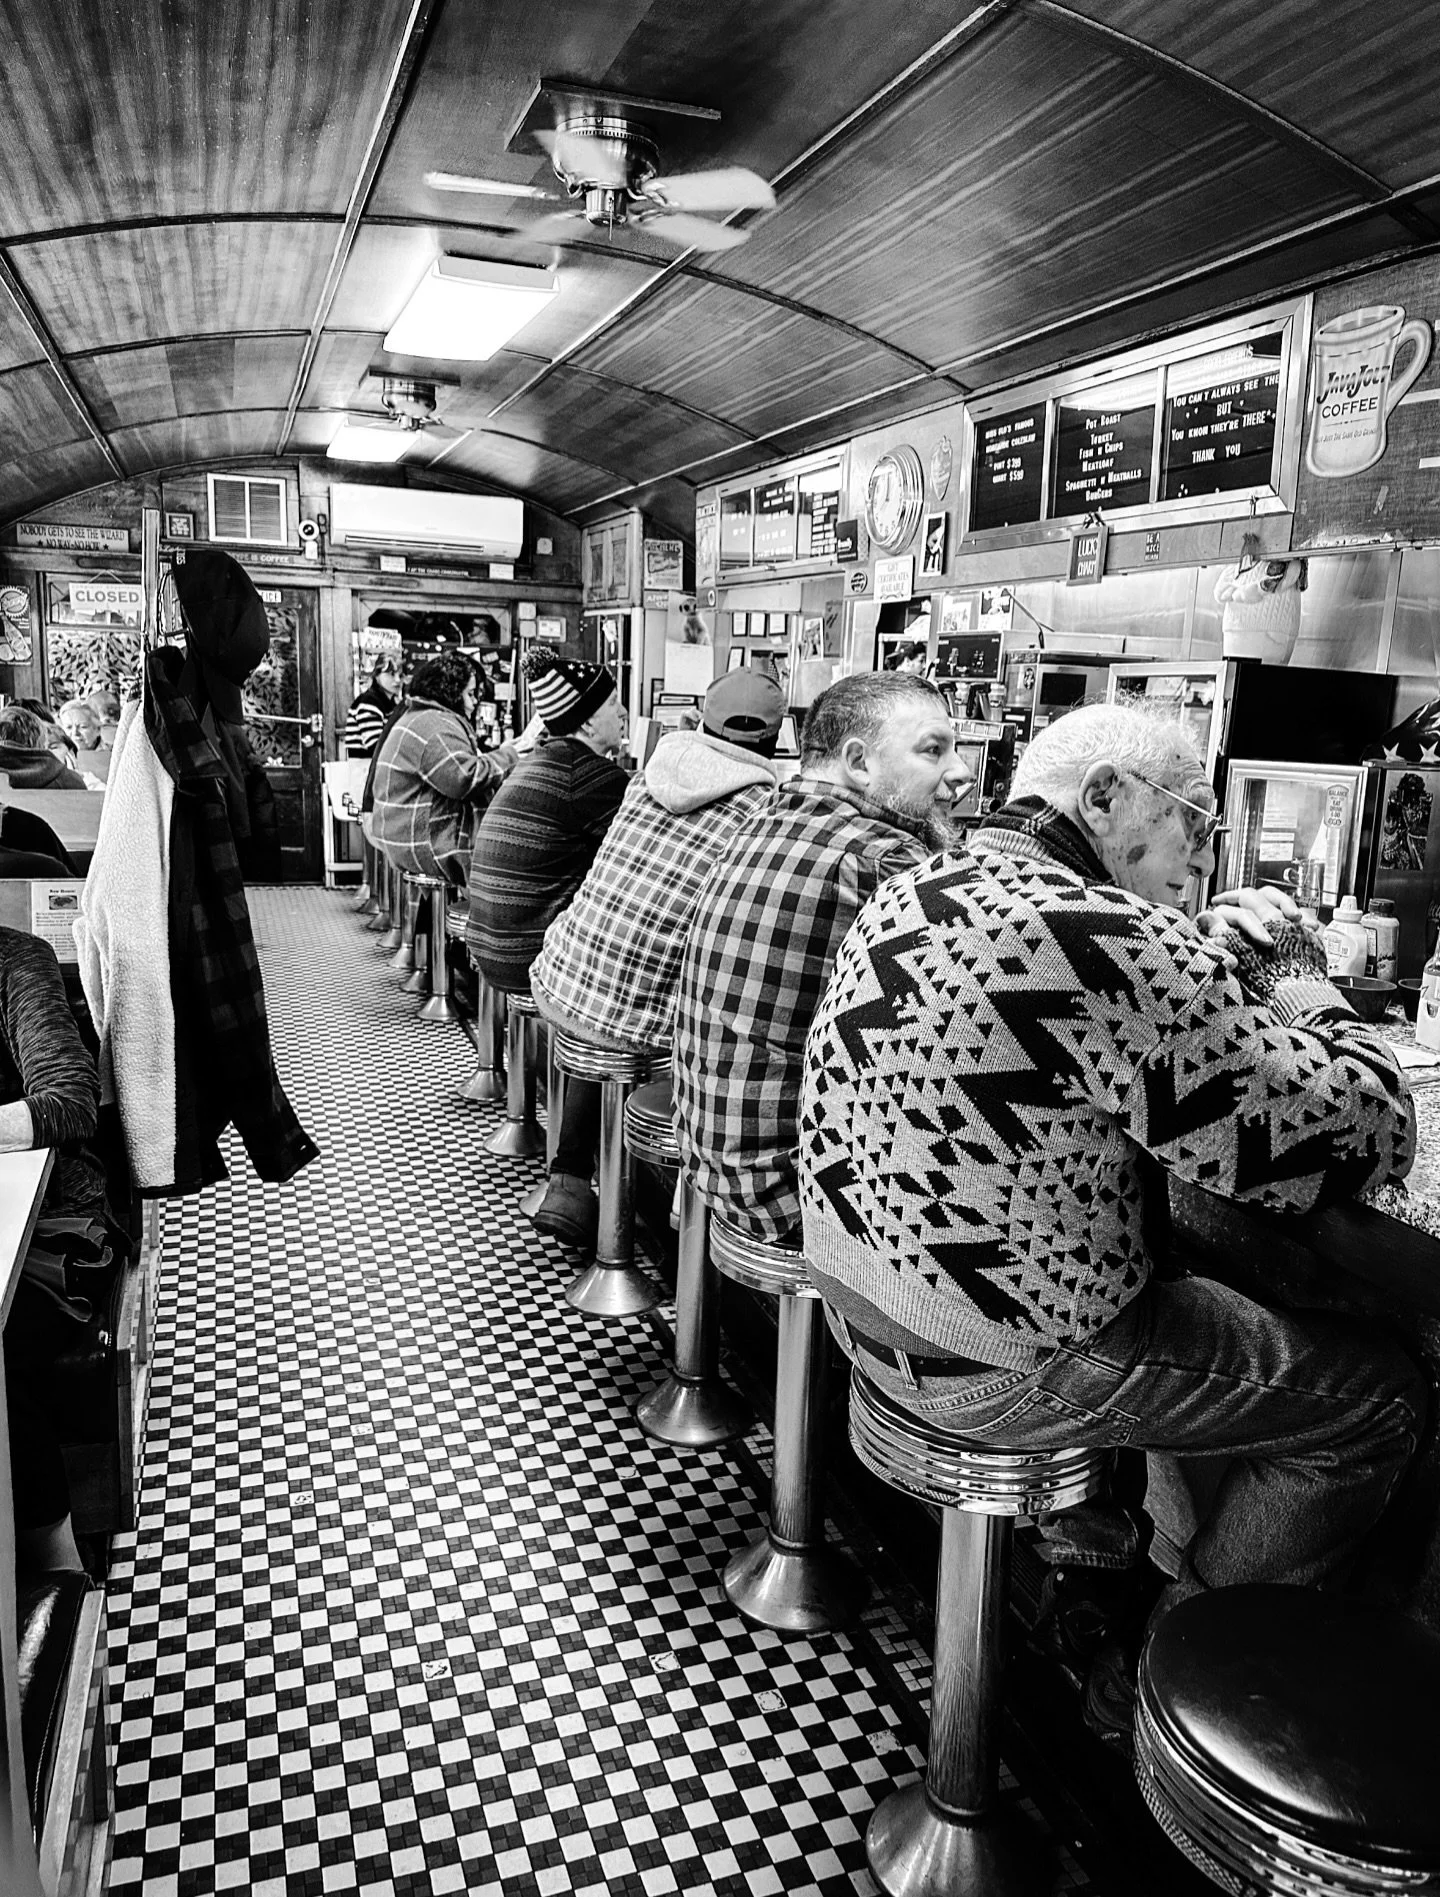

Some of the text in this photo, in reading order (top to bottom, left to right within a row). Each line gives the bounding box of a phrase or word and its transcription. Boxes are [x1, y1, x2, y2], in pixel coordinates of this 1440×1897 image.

[1173, 395, 1187, 407] YOU
[1211, 383, 1240, 399] ALWAYS
[1244, 379, 1259, 391] SEE
[1216, 401, 1232, 416] BUT
[1321, 396, 1378, 419] COFFEE
[1085, 413, 1121, 430] POT ROAST
[1171, 428, 1184, 441] YOU
[1211, 419, 1239, 434] THEY'RE
[1079, 448, 1094, 460] FISH
[1104, 441, 1123, 454] CHIPS
[1192, 443, 1241, 464] THANK YOU
[1082, 458, 1114, 472] MEATLOAF
[1065, 477, 1097, 492] SPAGHETTI
[1107, 468, 1142, 484] MEATBALLS
[20, 524, 125, 541] NOBODY GETS TO SEE THE WIZARD
[46, 538, 56, 549] NO
[260, 554, 289, 564] COFFEE
[75, 591, 140, 603] CLOSED
